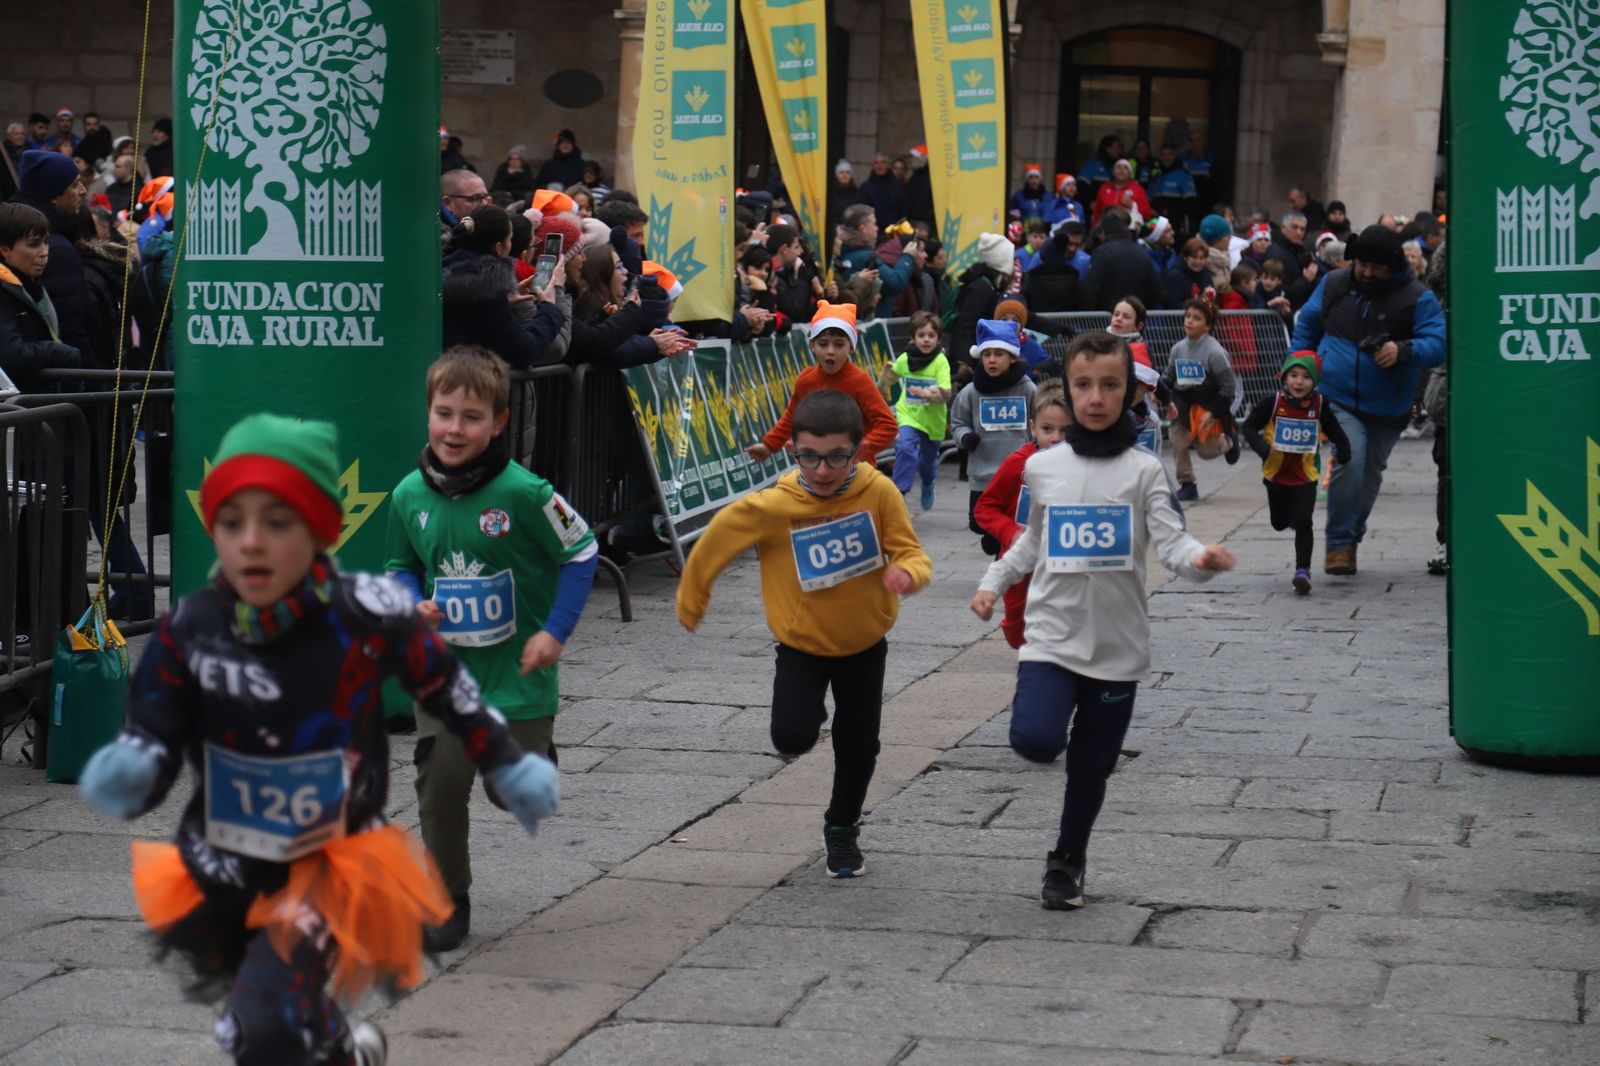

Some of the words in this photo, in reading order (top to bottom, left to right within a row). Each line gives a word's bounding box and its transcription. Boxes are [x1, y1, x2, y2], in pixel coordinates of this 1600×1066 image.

[187, 281, 384, 312] FUNDACION
[187, 314, 254, 348] CAJA
[262, 316, 385, 347] RURAL
[1499, 329, 1591, 364] CAJA
[1182, 366, 1199, 377] 021
[989, 406, 1018, 420] 144
[1282, 427, 1311, 442] 089
[808, 532, 863, 569] 035
[1060, 522, 1116, 549] 063
[446, 594, 502, 625] 010
[231, 779, 323, 827] 126
